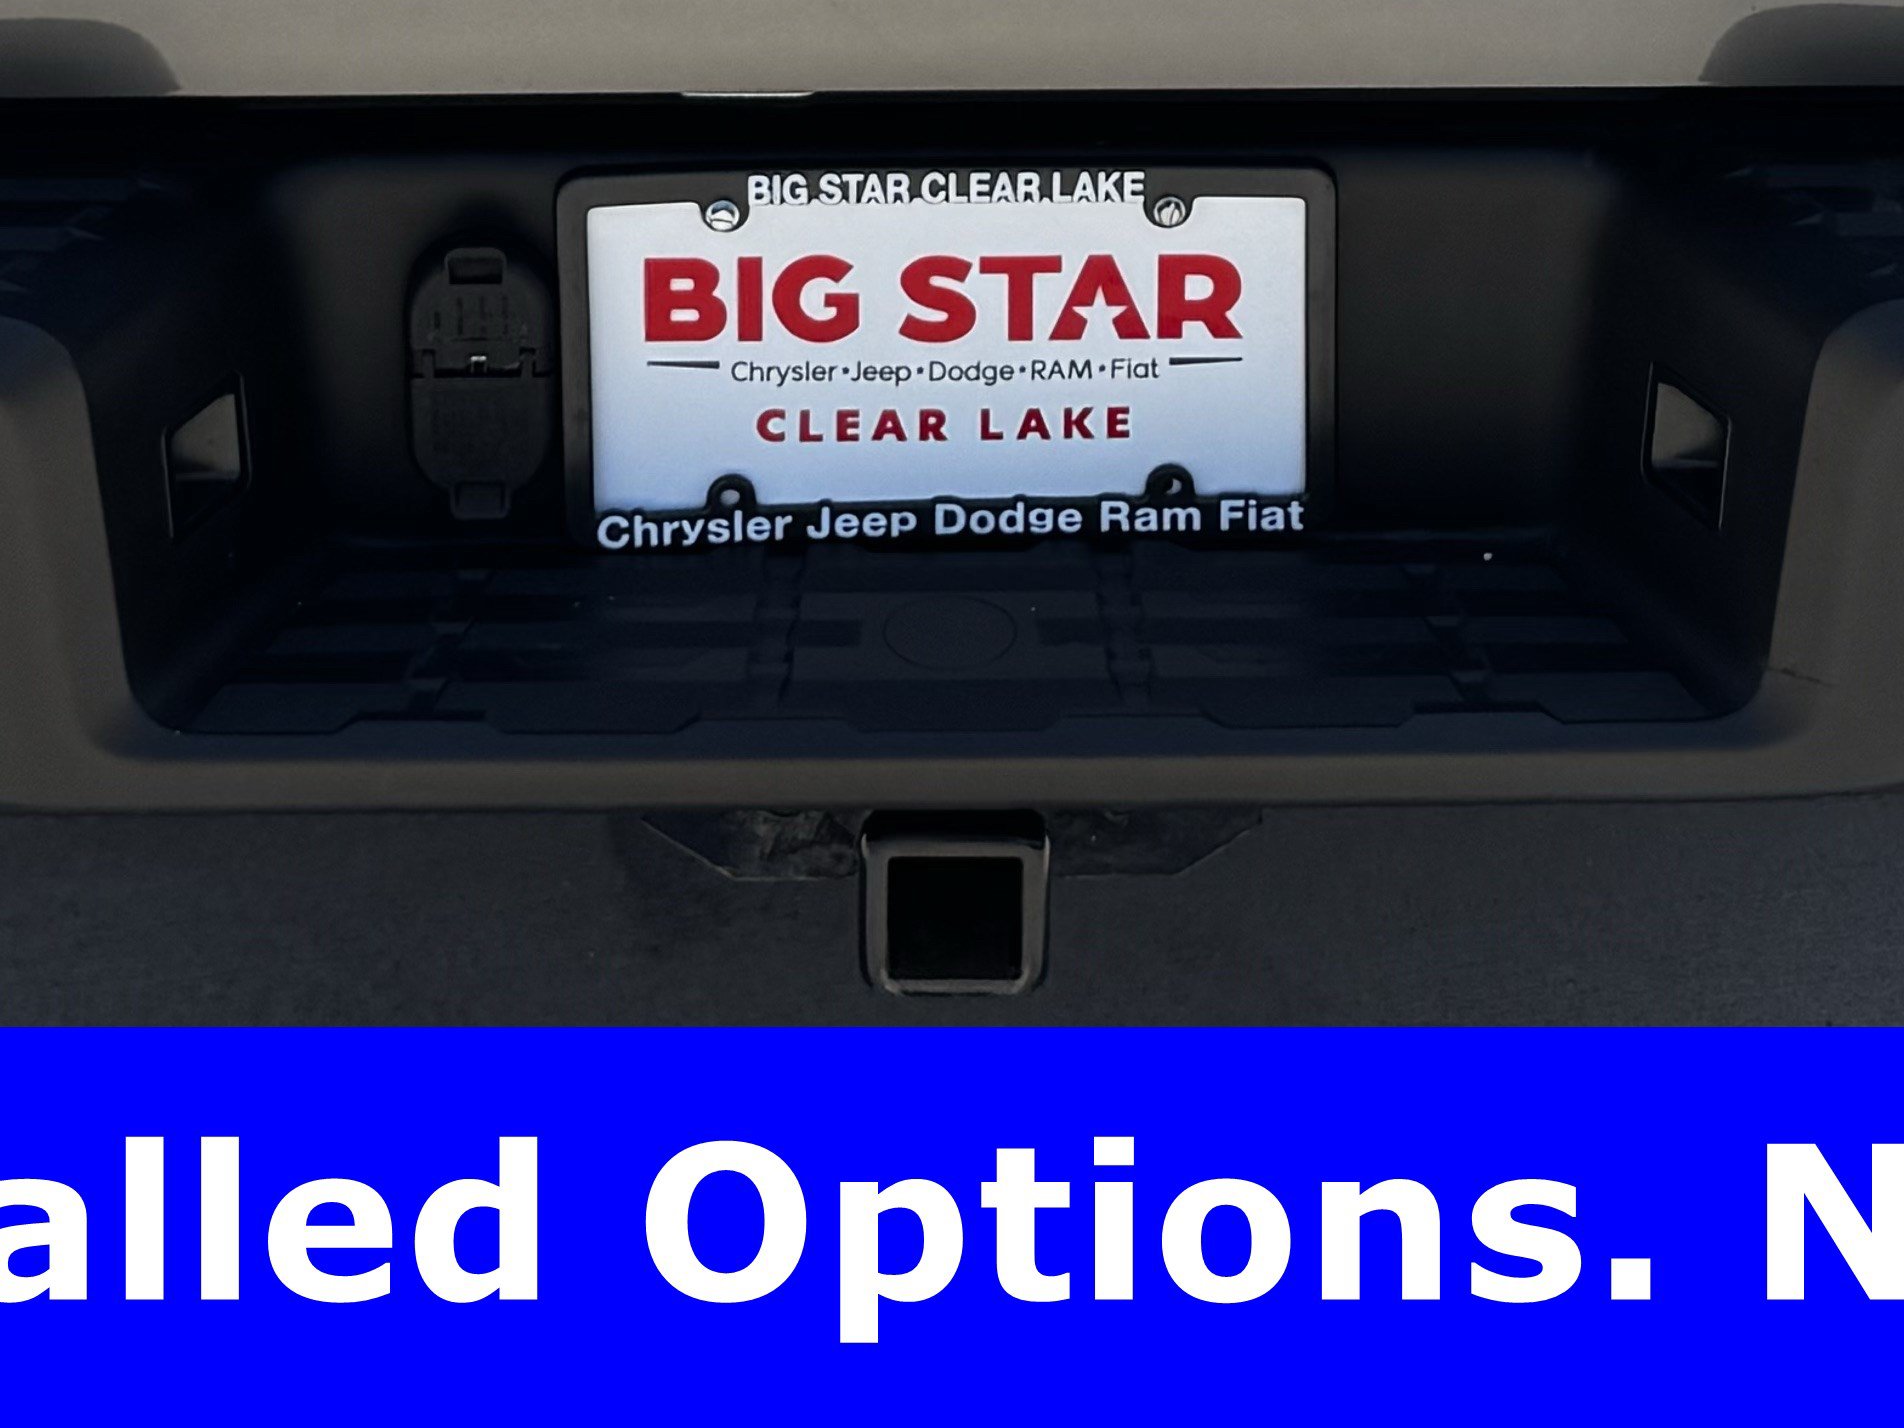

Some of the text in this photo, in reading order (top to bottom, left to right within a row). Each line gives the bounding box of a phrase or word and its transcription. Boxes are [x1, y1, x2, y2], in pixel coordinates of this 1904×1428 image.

[747, 170, 1146, 206] BIG STAR CLEAR LAKE
[643, 253, 1243, 344] BIG STAR
[731, 357, 1159, 387] Chrysler Jeep Dodge RAM Fiat
[756, 406, 1131, 442] CLEAR LAKE
[597, 499, 1304, 549] Chrysler Jeep Dodge Ram Fiat
